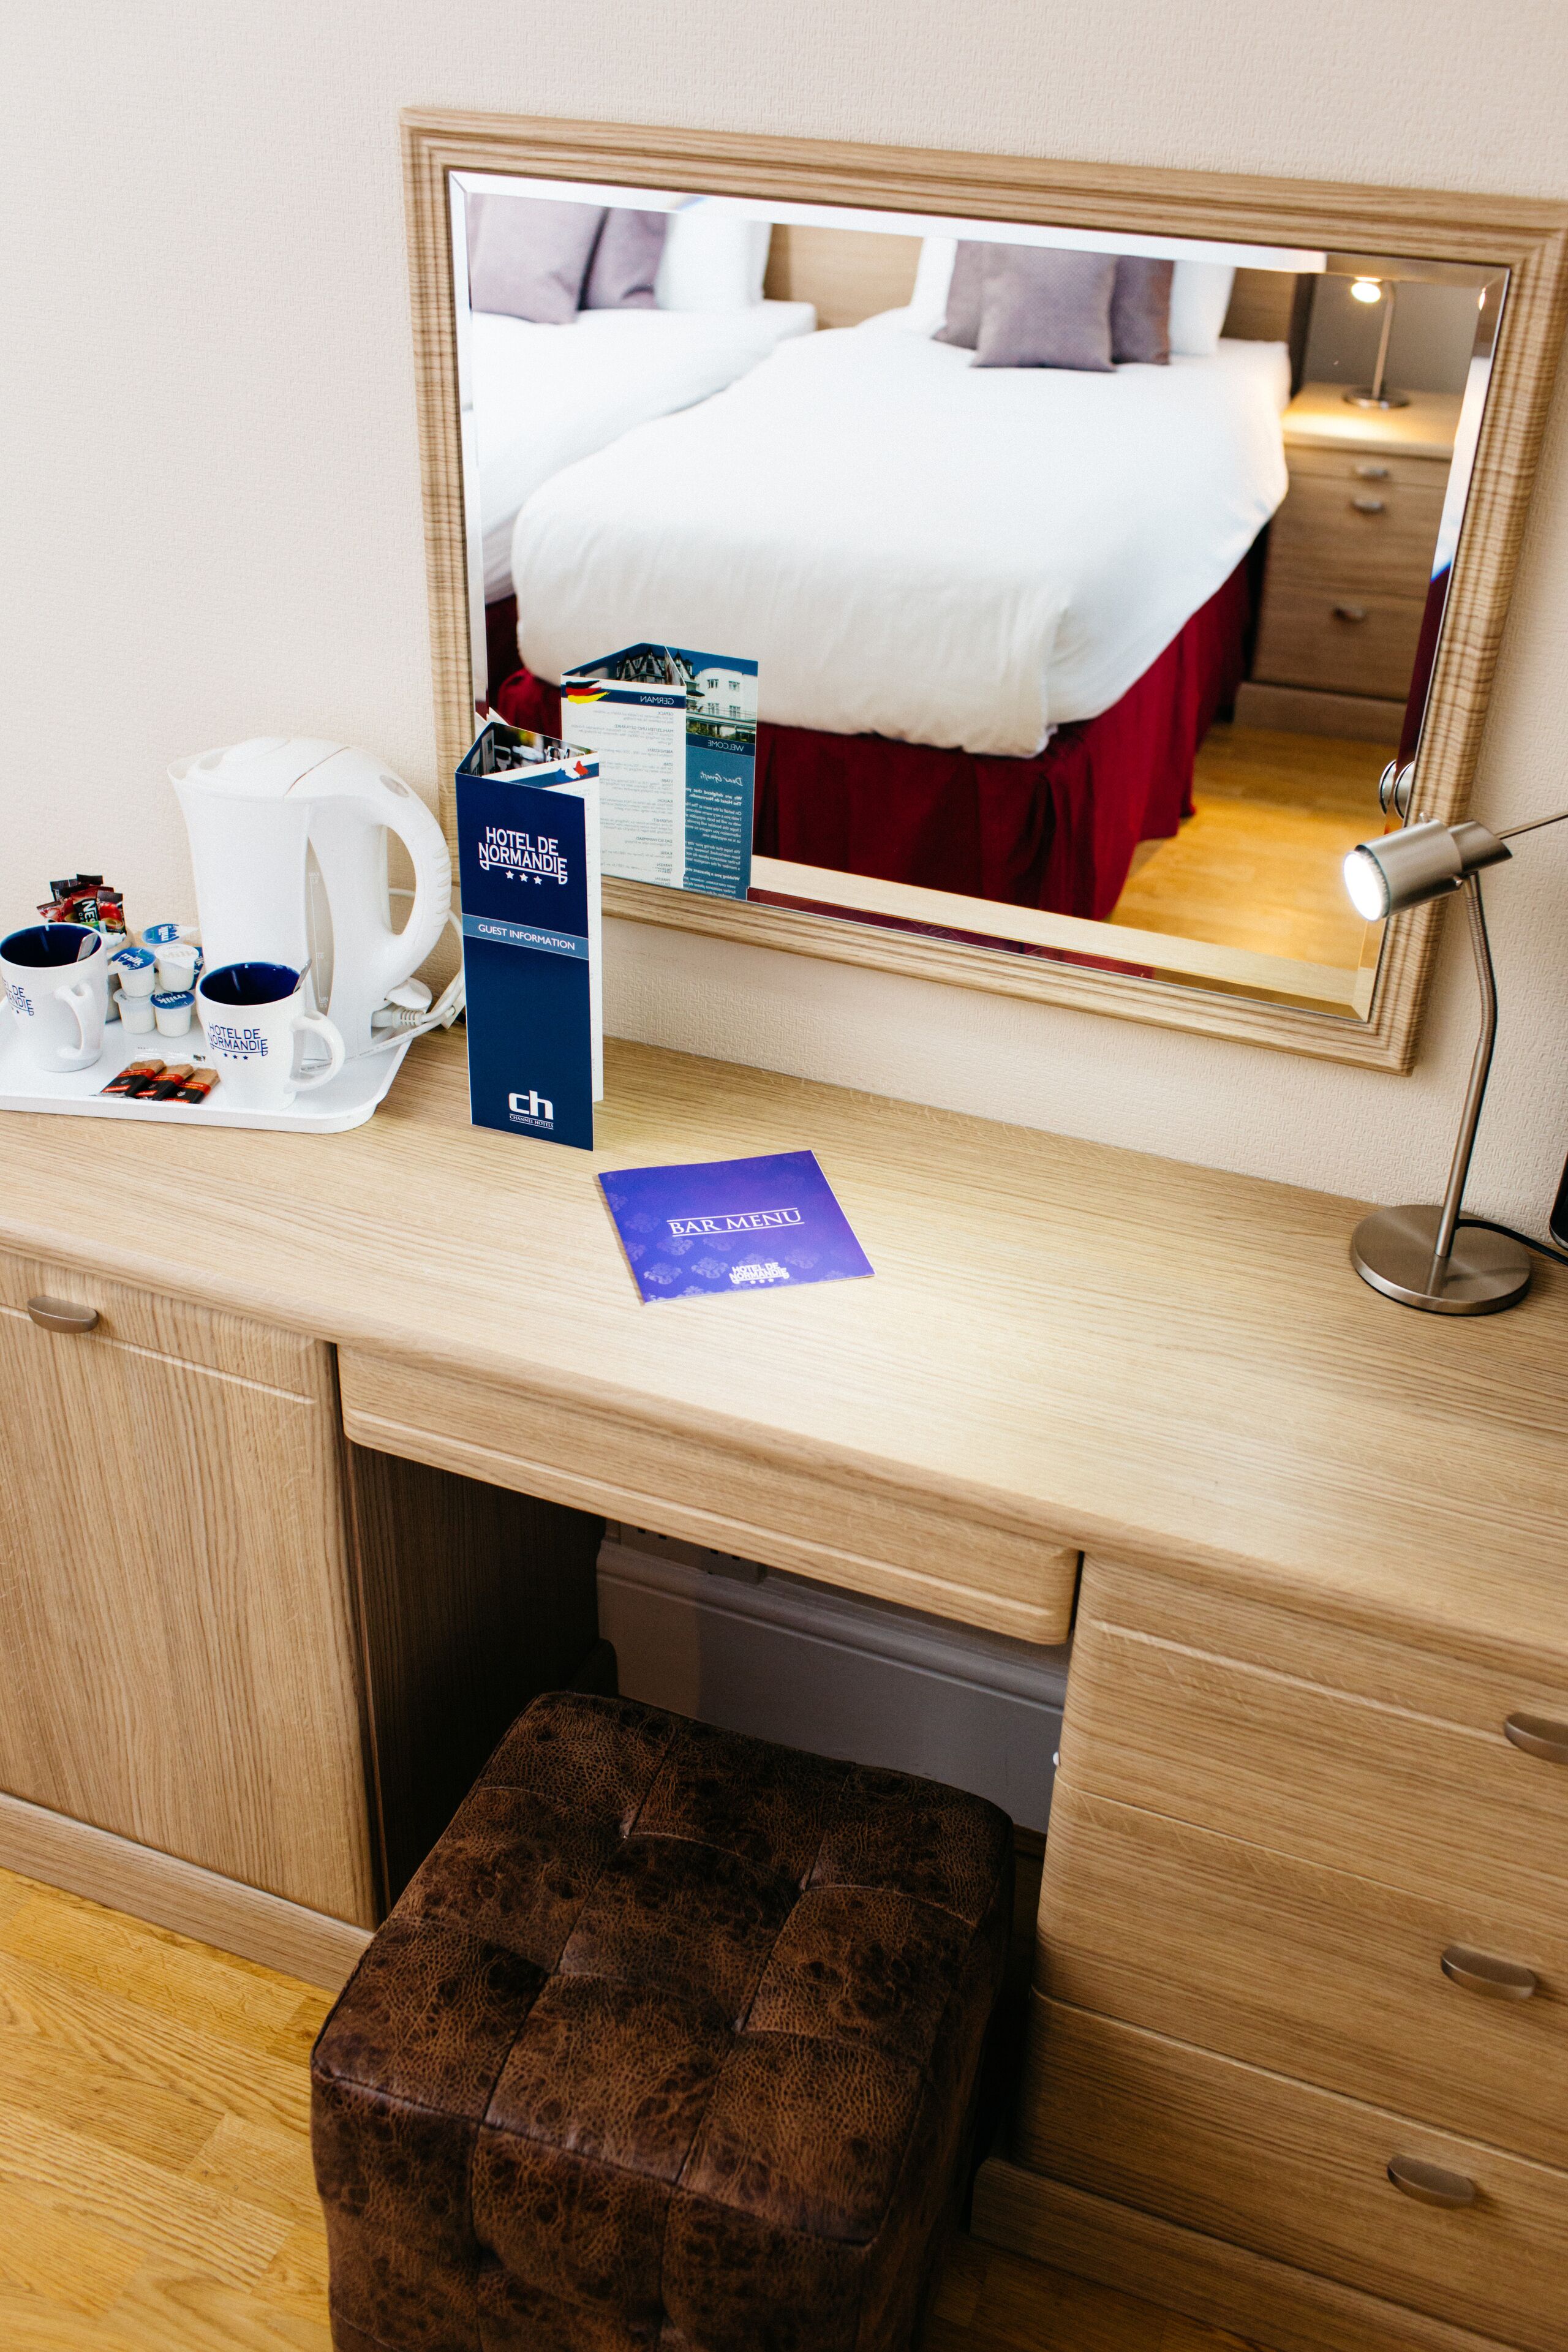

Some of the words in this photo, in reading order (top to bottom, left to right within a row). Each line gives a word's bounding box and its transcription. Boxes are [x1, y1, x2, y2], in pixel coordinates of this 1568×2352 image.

[486, 826, 535, 852] HOTEL
[538, 836, 559, 856] DE
[478, 842, 568, 884] NORMANDIE
[158, 925, 170, 941] milk
[478, 924, 508, 937] GUEST
[510, 929, 576, 951] INFORMATION
[121, 953, 145, 967] milk
[12, 984, 26, 998] DE
[157, 993, 187, 1005] milk
[209, 1022, 242, 1040] HOTEL
[244, 1028, 261, 1040] DE
[208, 1031, 268, 1057] NORMANDIE
[508, 1090, 554, 1120] ch
[510, 1115, 534, 1125] CHANNEL
[535, 1120, 554, 1128] HOTELS
[668, 1219, 722, 1234] BAR
[726, 1210, 802, 1229] MENU
[729, 1267, 790, 1284] NORMANDIE
[731, 1264, 763, 1275] HOTEL
[764, 1262, 778, 1271] DE
